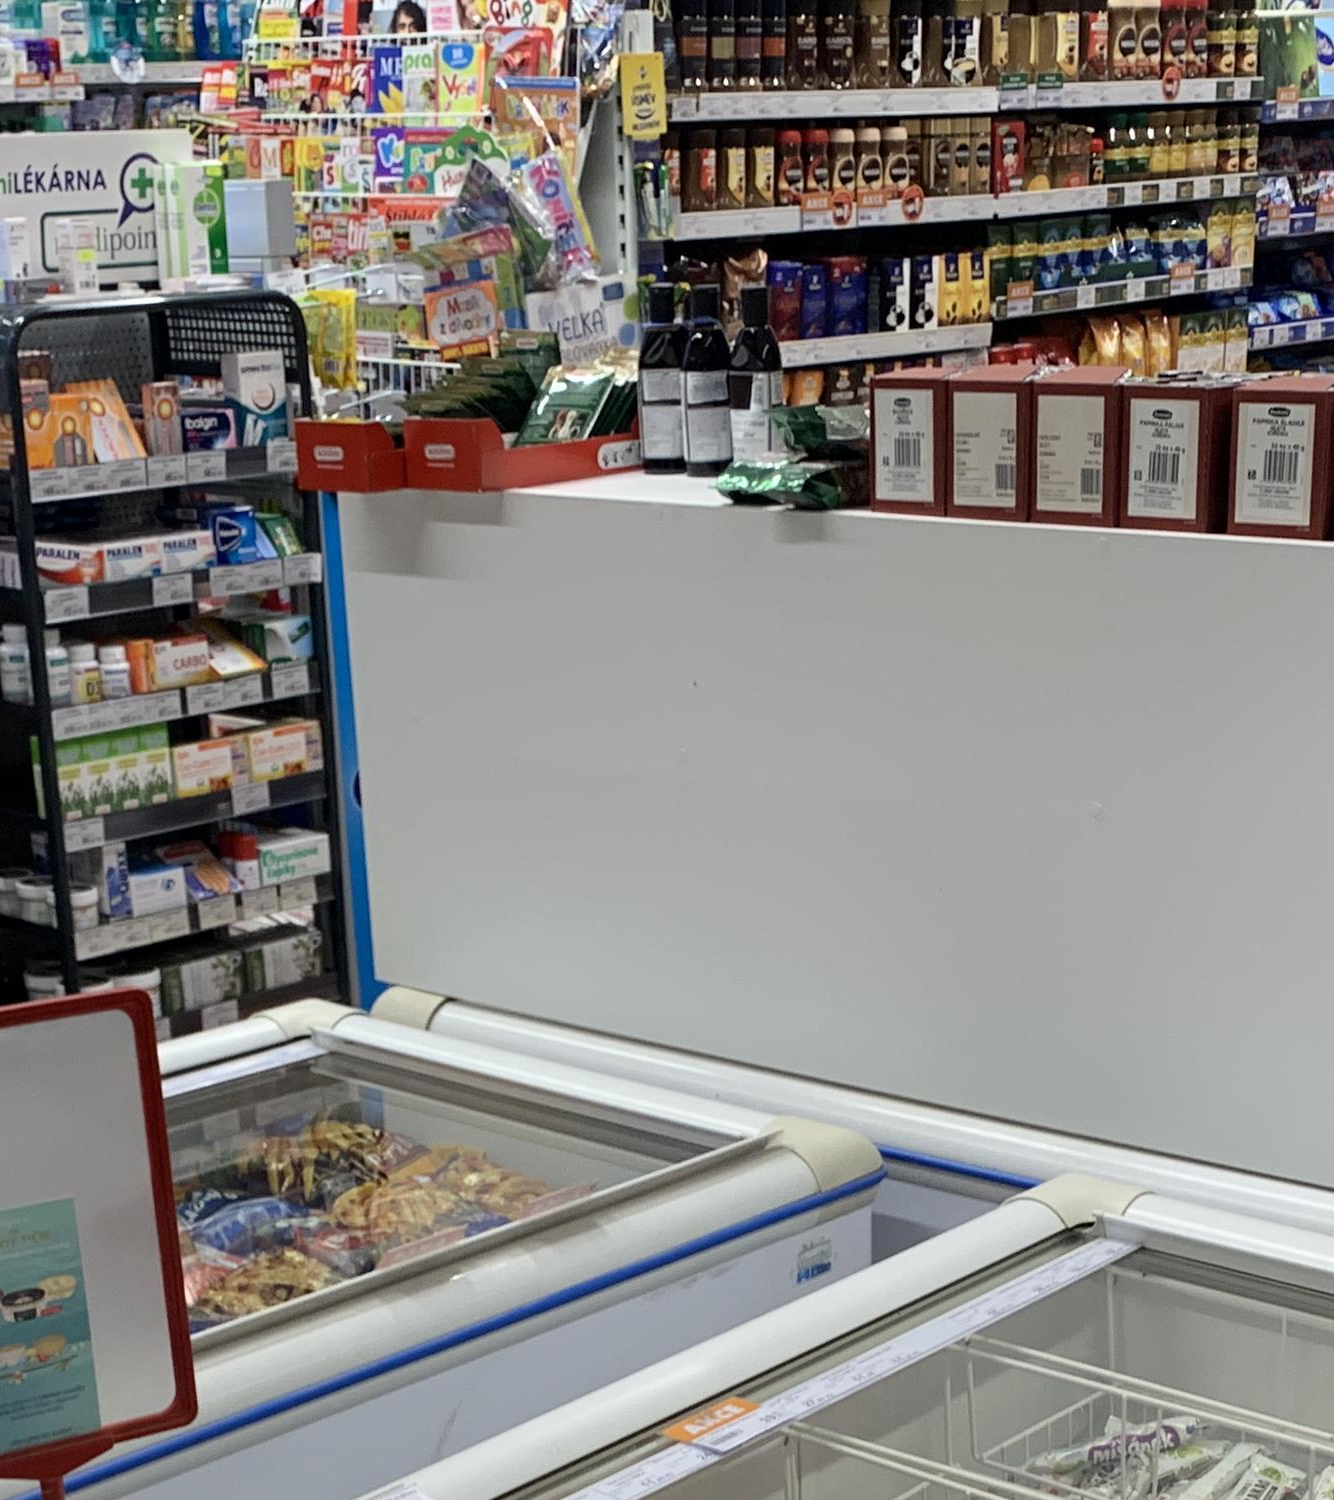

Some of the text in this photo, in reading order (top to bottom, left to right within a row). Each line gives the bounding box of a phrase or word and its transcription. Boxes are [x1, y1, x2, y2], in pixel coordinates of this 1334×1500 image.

[163, 538, 197, 551] PARALEN
[36, 548, 80, 562] PARALEN
[106, 546, 143, 558] PARALEN
[173, 655, 208, 671] CARBO
